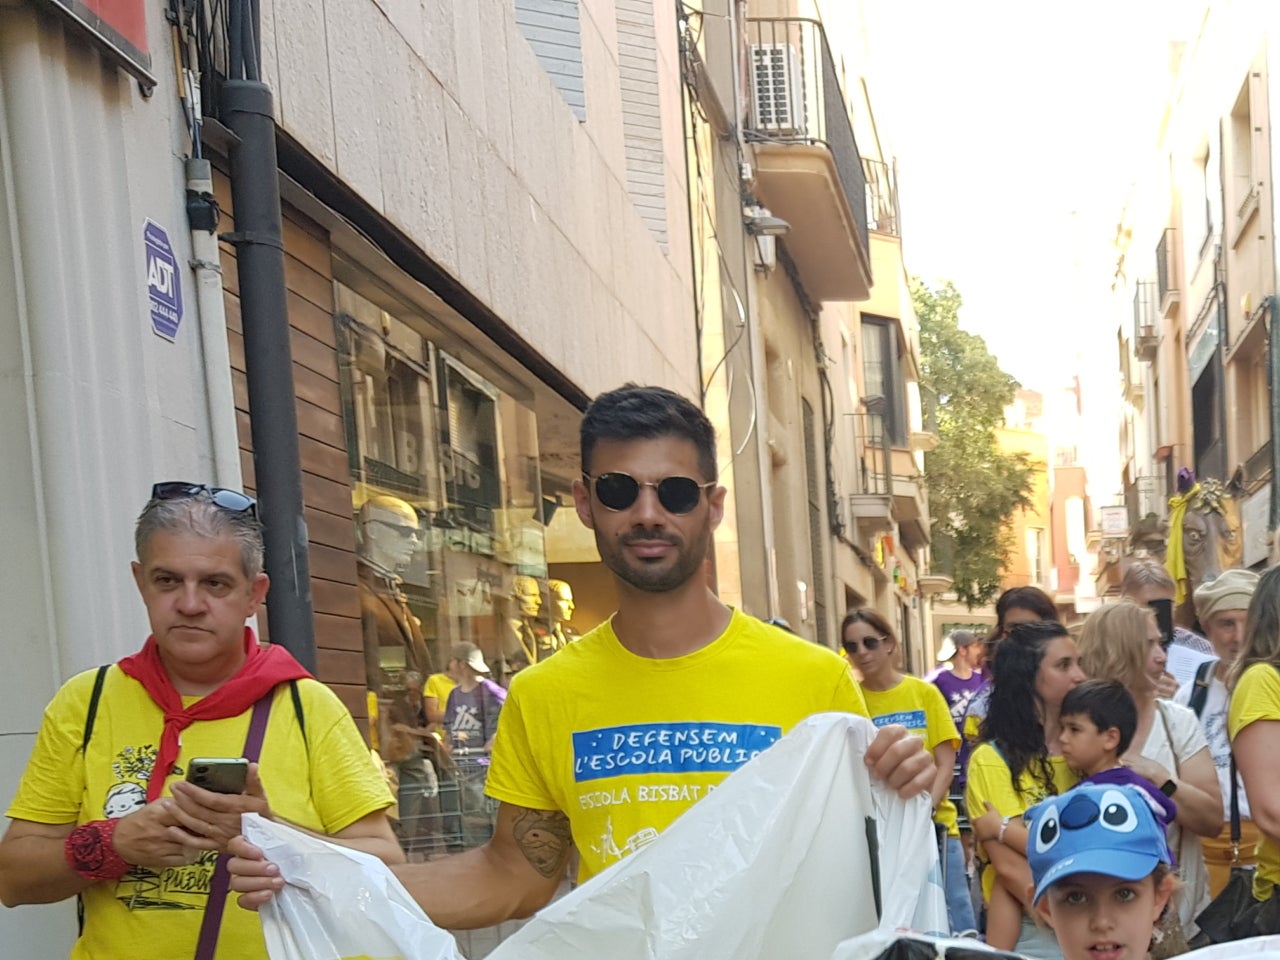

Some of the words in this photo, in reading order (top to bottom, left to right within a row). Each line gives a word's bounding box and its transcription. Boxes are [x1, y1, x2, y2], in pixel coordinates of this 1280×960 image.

[148, 254, 174, 299] ADT
[612, 729, 738, 750] DEFENSEM
[575, 750, 673, 774] L'ESCOLA
[680, 747, 764, 765] PÚBLIC
[579, 786, 632, 810] ESCOLA
[638, 784, 701, 802] BISBAT
